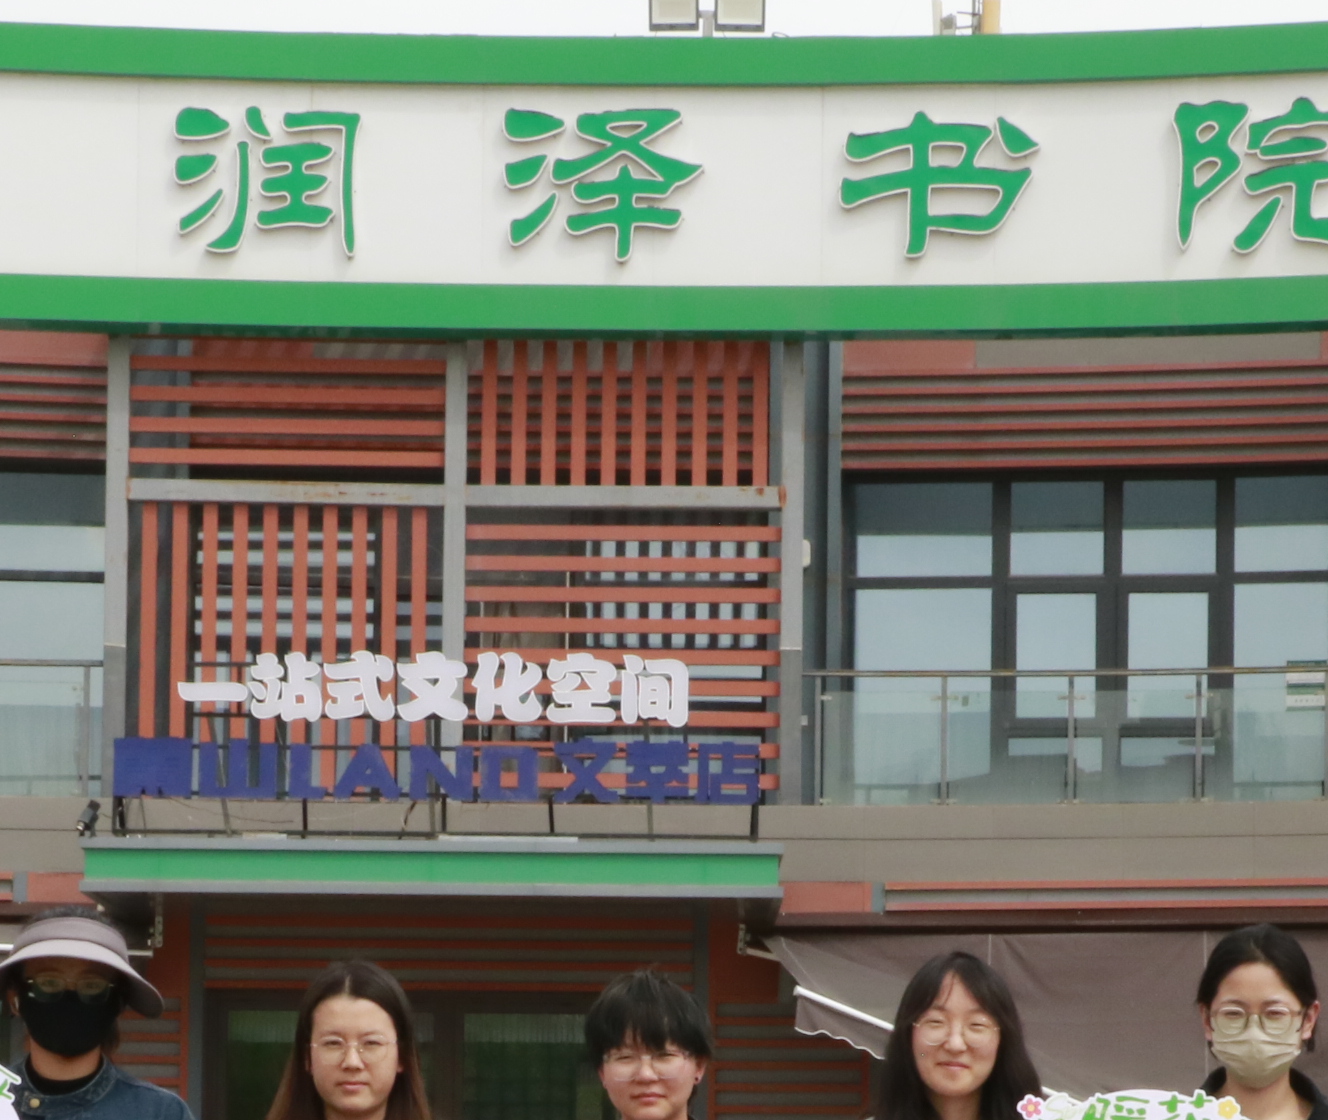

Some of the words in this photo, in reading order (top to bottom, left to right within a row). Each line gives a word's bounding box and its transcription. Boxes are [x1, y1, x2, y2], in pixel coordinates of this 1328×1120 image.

[178, 651, 689, 727] 一站式文化空间
